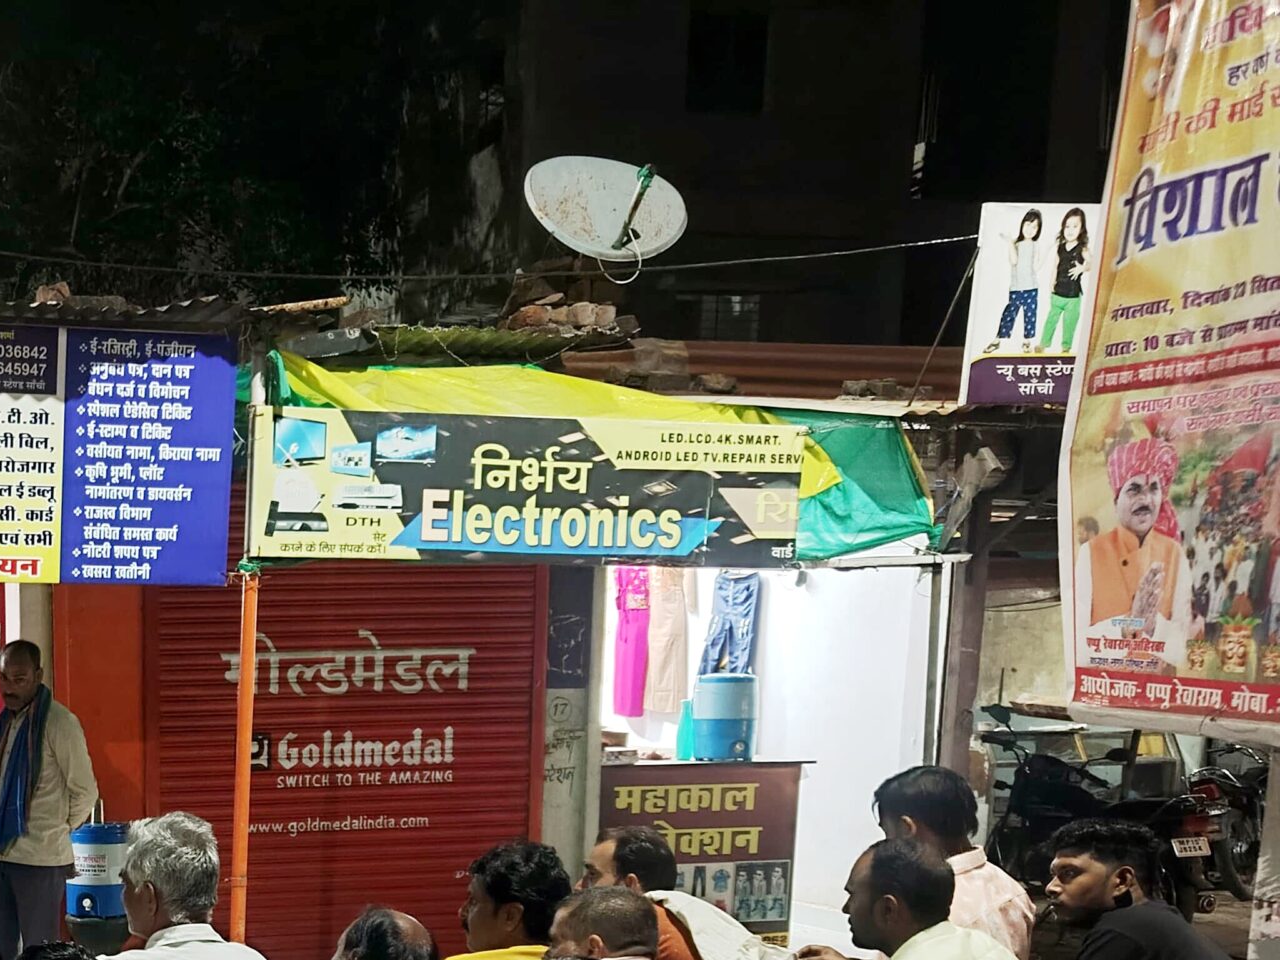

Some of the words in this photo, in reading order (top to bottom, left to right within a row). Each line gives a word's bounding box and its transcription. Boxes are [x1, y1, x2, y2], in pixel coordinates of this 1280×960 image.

[1117, 153, 1269, 265] विशाल
[1143, 335, 1159, 351] 10
[1200, 324, 1215, 343] से
[145, 340, 196, 358] ई-पंजीयन
[152, 364, 172, 378] दान
[175, 364, 195, 379] पत्र
[996, 365, 1015, 381] न्यू
[1017, 365, 1042, 376] बस
[1045, 360, 1075, 376] स्टेण
[138, 385, 147, 397] व
[149, 383, 190, 399] विमोचन
[1018, 378, 1055, 395] साँची
[87, 403, 120, 418] स्पेशल
[162, 405, 192, 420] टिकिट
[87, 424, 128, 438] ई-स्टाम्प
[130, 427, 138, 438] व
[141, 424, 172, 439] टिकिट
[87, 443, 123, 459] वसीयत
[127, 448, 155, 462] नामा,
[159, 446, 192, 461] किराया
[196, 448, 221, 461] नामा
[617, 450, 672, 461] ANDROID
[676, 451, 698, 462] LED
[86, 463, 107, 482] कृषि
[139, 463, 164, 480] प्लॉट
[471, 443, 593, 494] निर्भय
[85, 484, 133, 500] नामांतरण
[137, 487, 145, 500] व
[148, 485, 192, 502] डायवर्सन
[84, 506, 116, 520] राजस्व
[120, 506, 151, 520] विभाग
[346, 517, 381, 526] DTH
[421, 488, 682, 548] Electronics
[0, 529, 21, 545] एवं
[24, 531, 52, 546] सभी
[123, 528, 153, 541] समस्त
[156, 525, 178, 543] कार्य
[373, 533, 387, 542] सेट
[83, 544, 111, 557] नोटरी
[143, 547, 162, 559] पत्र
[280, 542, 302, 552] करने
[306, 542, 316, 552] के
[319, 542, 336, 552] लिए
[339, 542, 364, 553] संपर्क
[772, 543, 794, 559] वार्ड
[82, 564, 112, 579] खसरा
[114, 564, 150, 579] खतौनी
[1146, 682, 1172, 709] पप्पू
[553, 704, 568, 716] 17
[277, 726, 455, 770] Goldmedal
[277, 773, 330, 788] SWITCH
[336, 773, 352, 786] TO
[359, 772, 382, 785] THE
[389, 771, 453, 784] AMAZING
[614, 783, 760, 814] महाकाल
[248, 816, 429, 837] www.goldmedalindia.com
